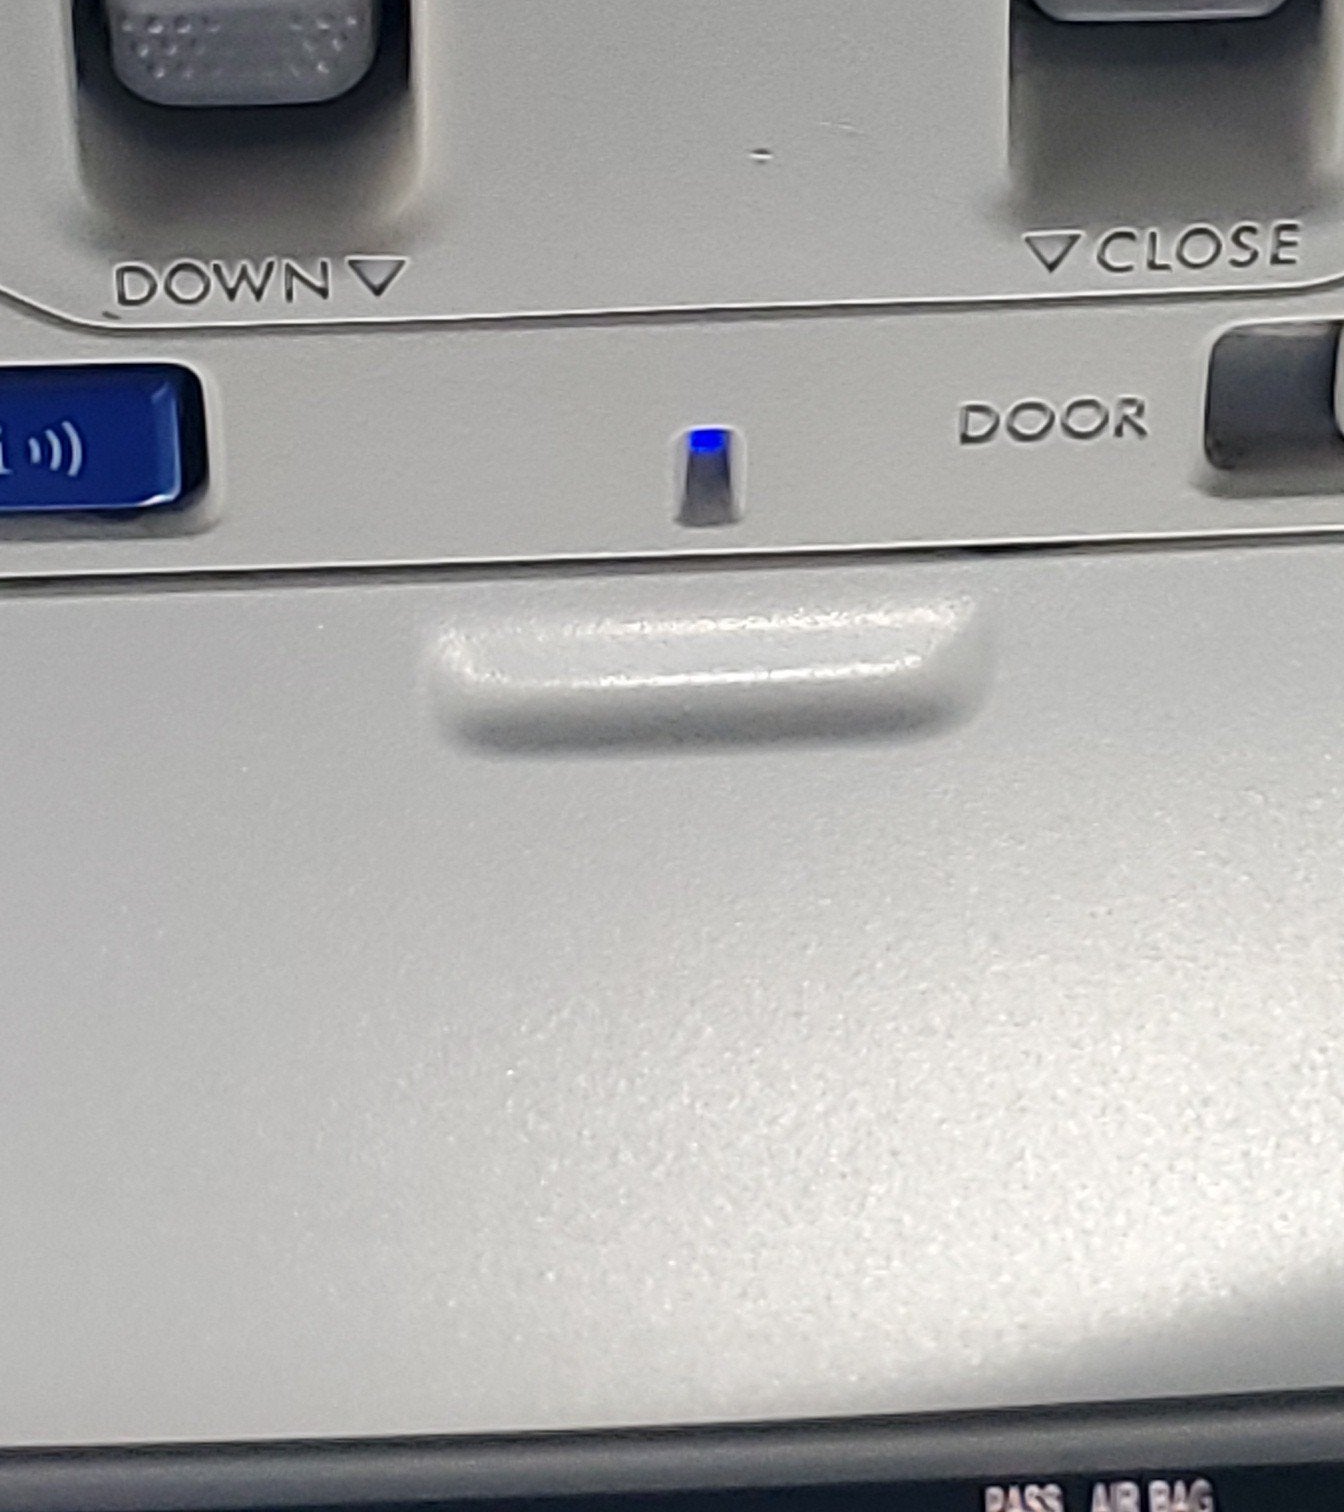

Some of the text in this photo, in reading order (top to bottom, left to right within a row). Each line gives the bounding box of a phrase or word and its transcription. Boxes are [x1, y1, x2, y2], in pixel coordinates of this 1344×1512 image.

[1096, 222, 1301, 273] CLOSE
[115, 258, 330, 306] DOWN
[959, 397, 1148, 445] DOOR
